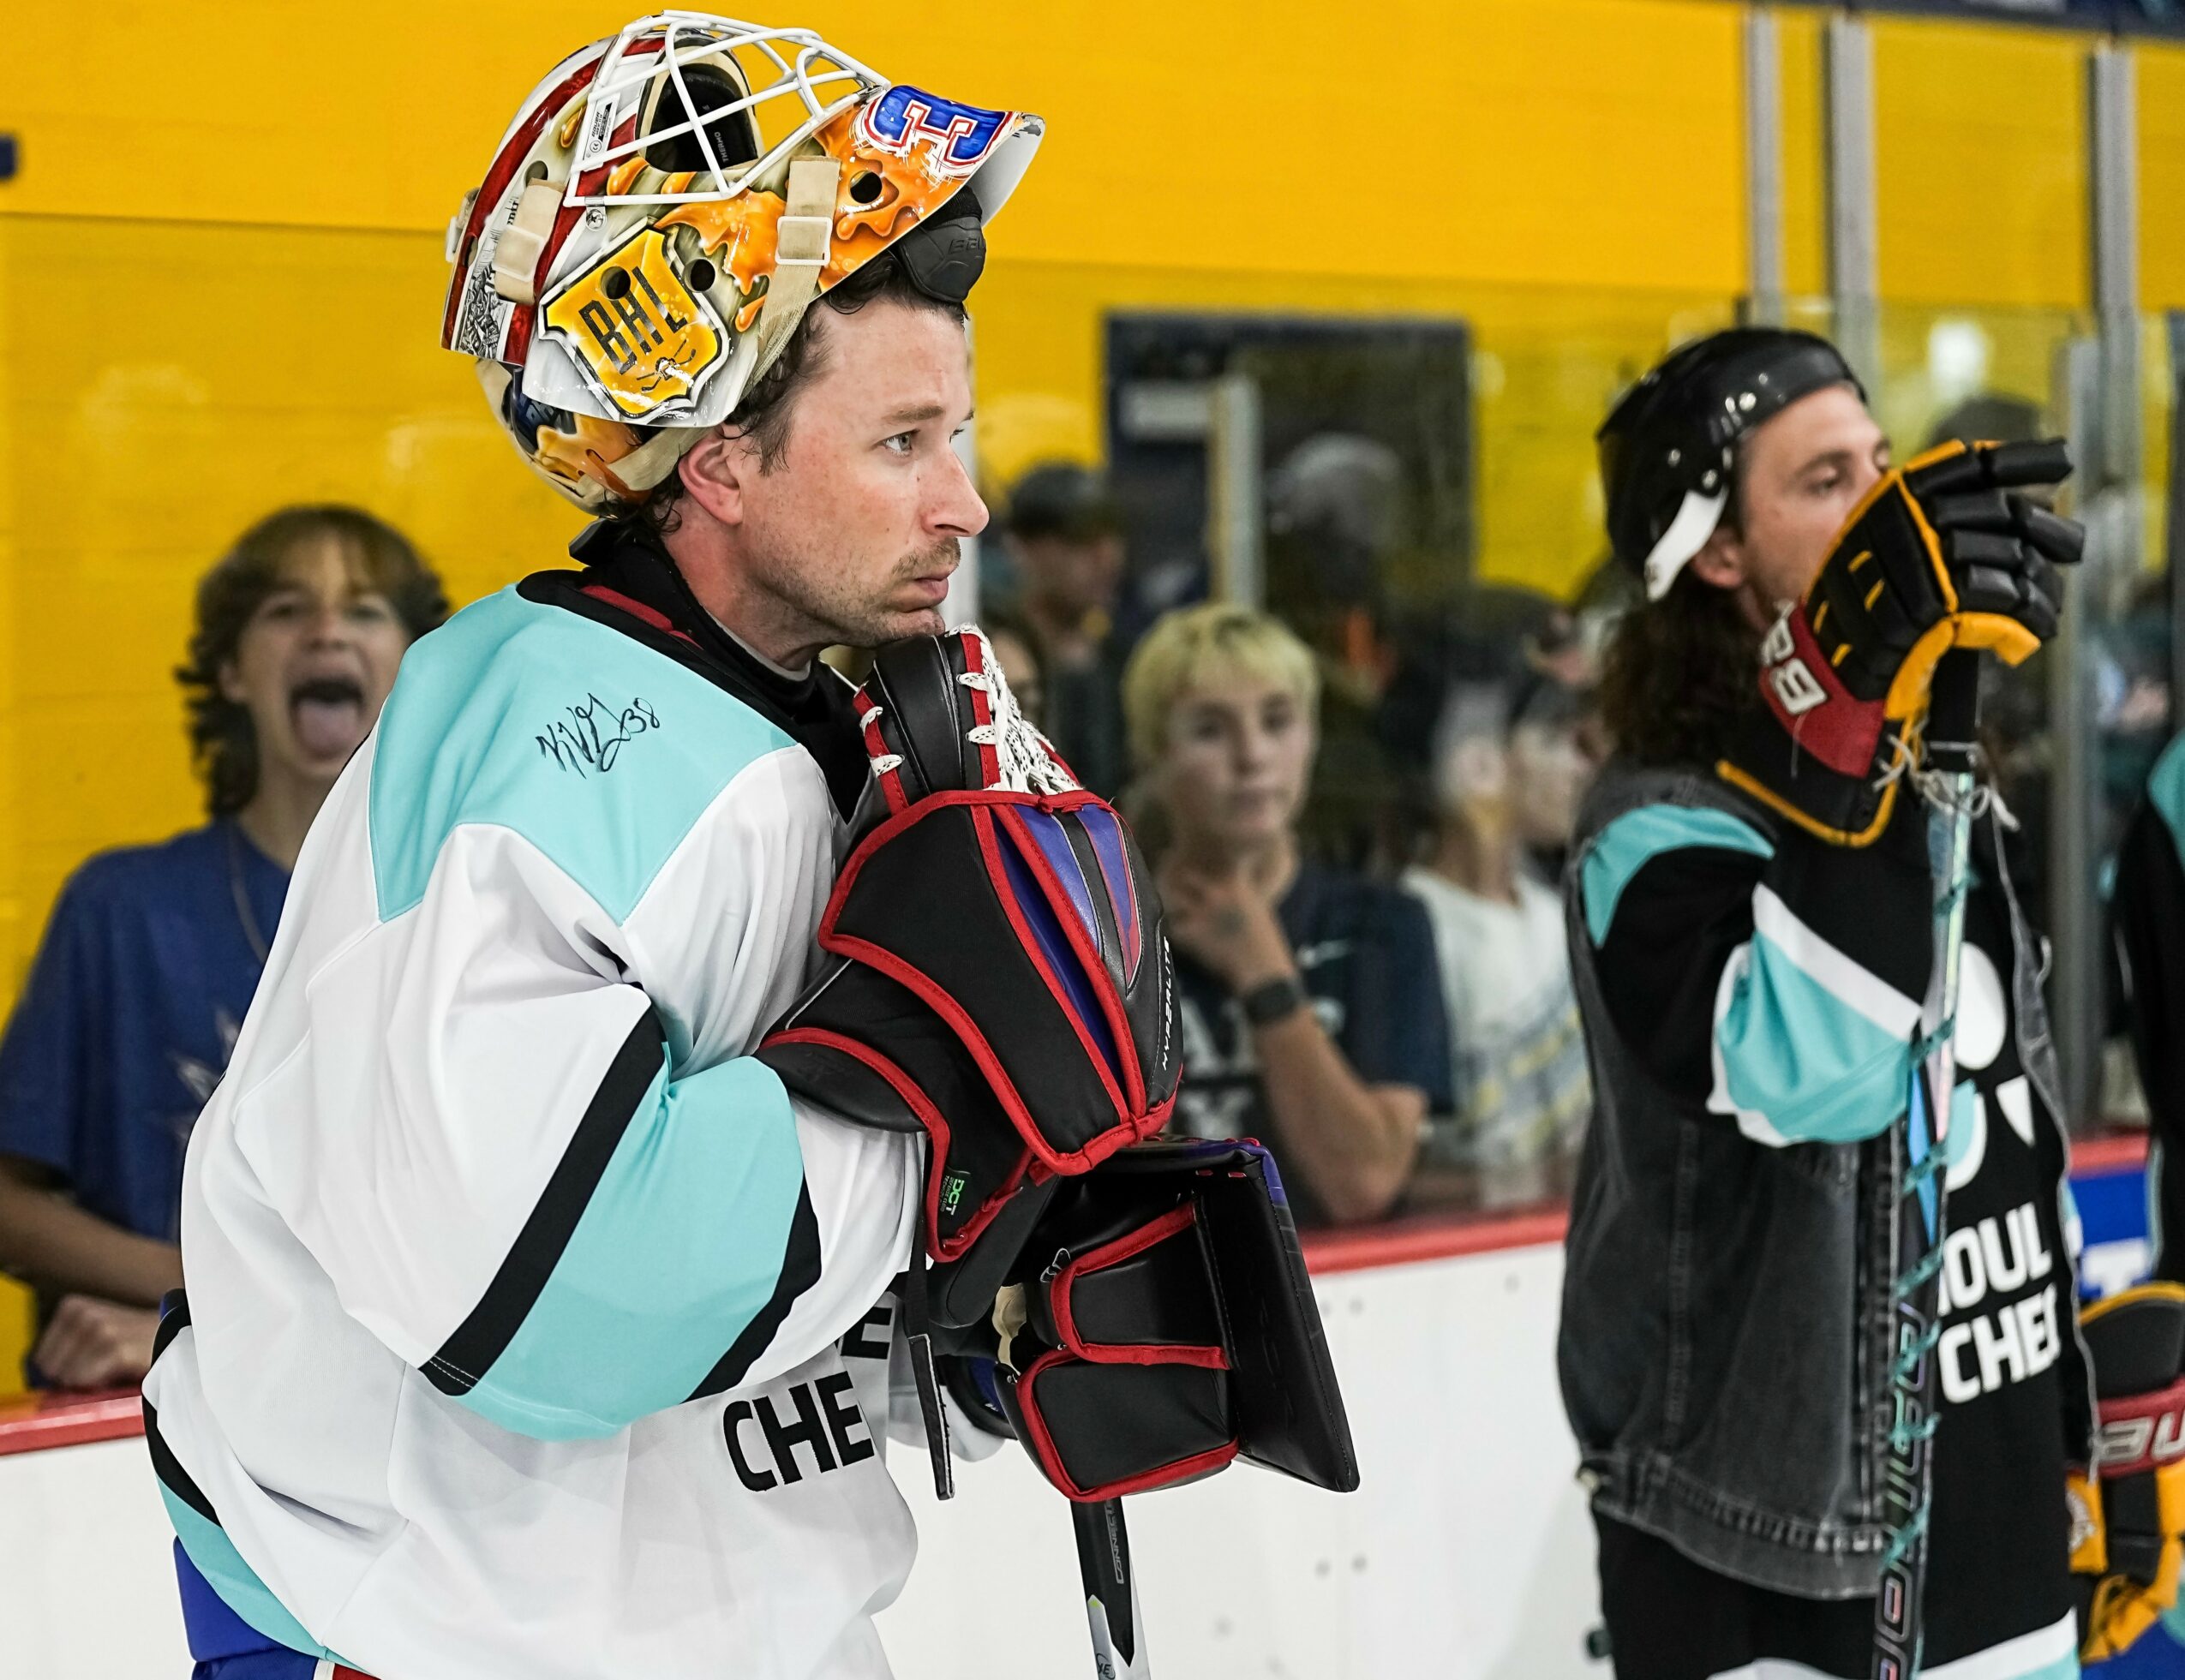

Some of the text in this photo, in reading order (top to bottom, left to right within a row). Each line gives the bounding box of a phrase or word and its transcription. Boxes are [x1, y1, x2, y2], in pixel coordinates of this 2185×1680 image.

[714, 131, 729, 163] THERMO
[1761, 601, 1828, 716] BA
[723, 1371, 875, 1492] CHE
